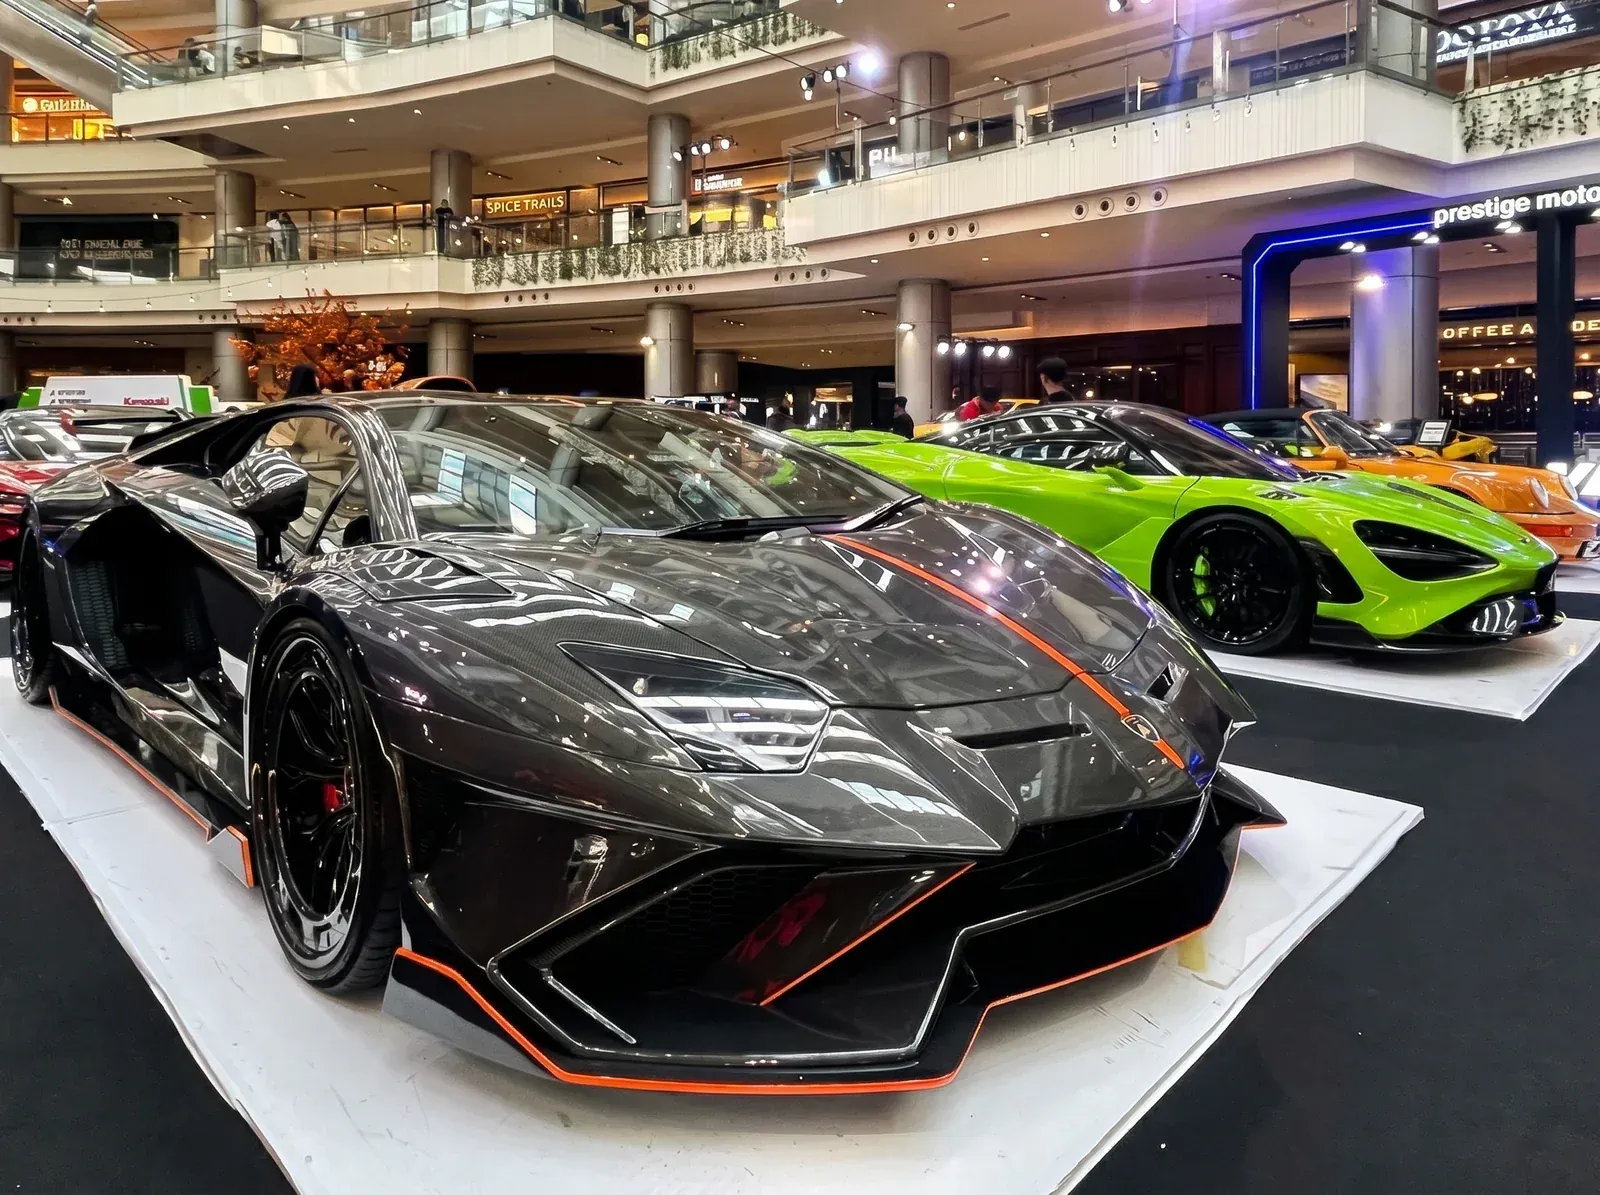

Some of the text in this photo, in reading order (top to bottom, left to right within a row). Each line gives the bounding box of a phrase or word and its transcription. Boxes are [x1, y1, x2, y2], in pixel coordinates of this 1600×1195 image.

[486, 196, 564, 214] SPICE TRAILS
[1434, 196, 1530, 228] prestige
